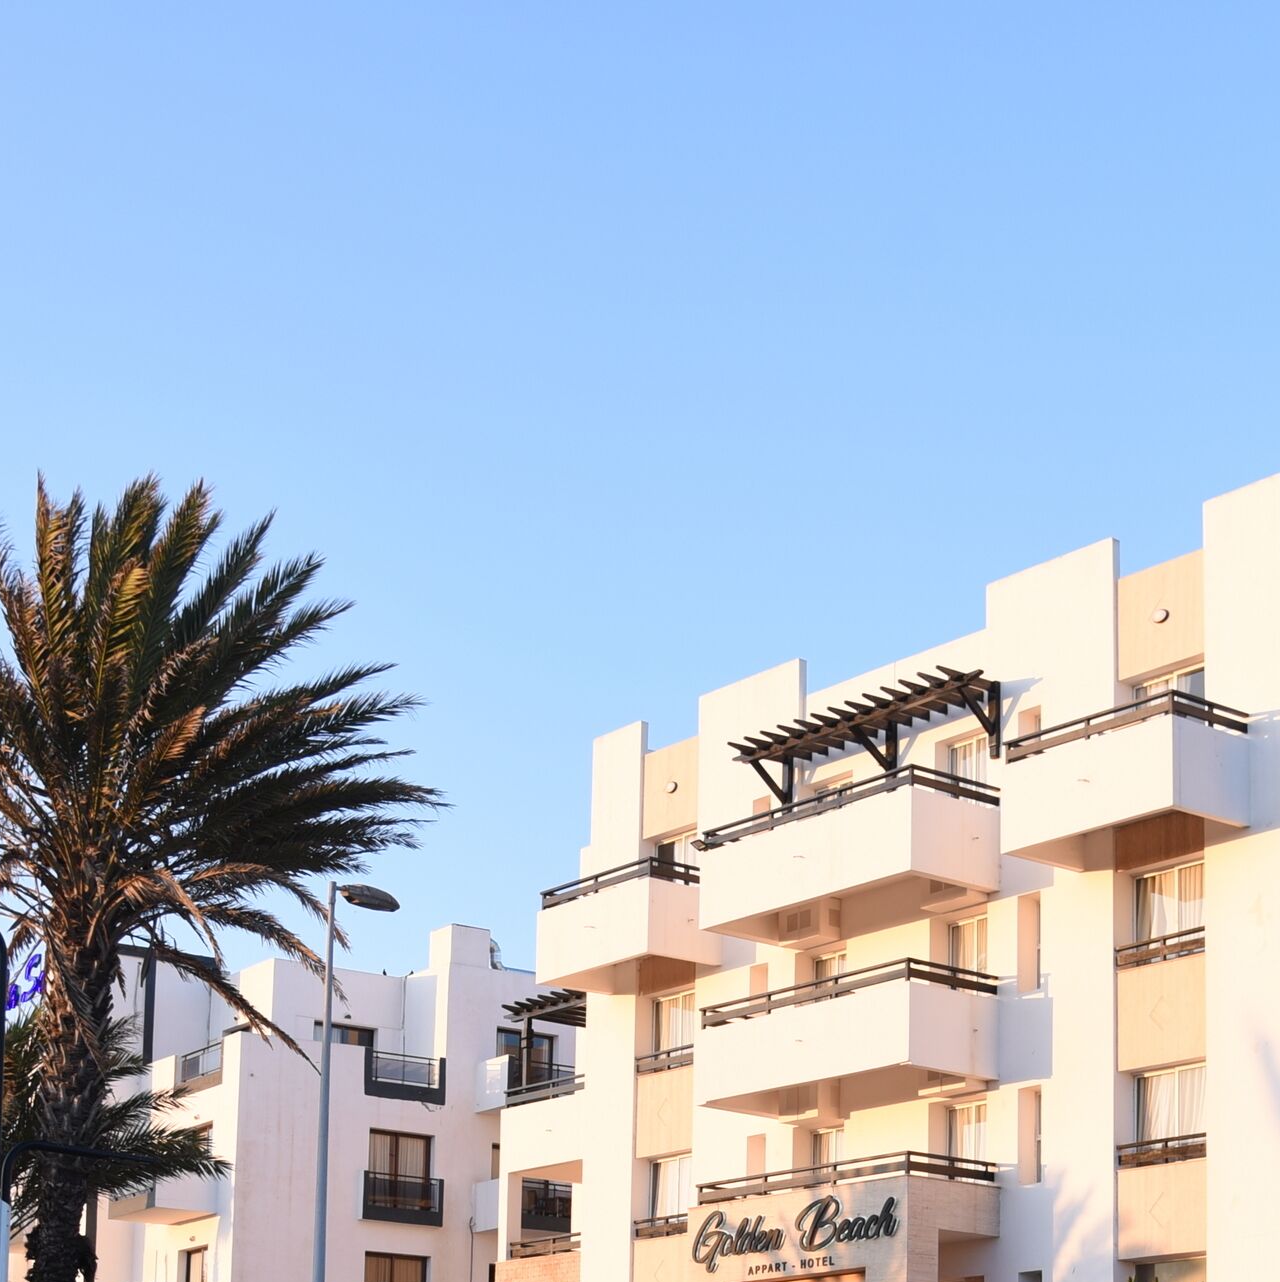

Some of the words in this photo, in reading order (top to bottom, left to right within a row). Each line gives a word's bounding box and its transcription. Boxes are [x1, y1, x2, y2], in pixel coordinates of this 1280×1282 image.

[692, 1210, 784, 1273] Golden
[795, 1195, 899, 1252] Beach
[748, 1261, 788, 1276] APPART
[800, 1255, 836, 1269] HOTEL
